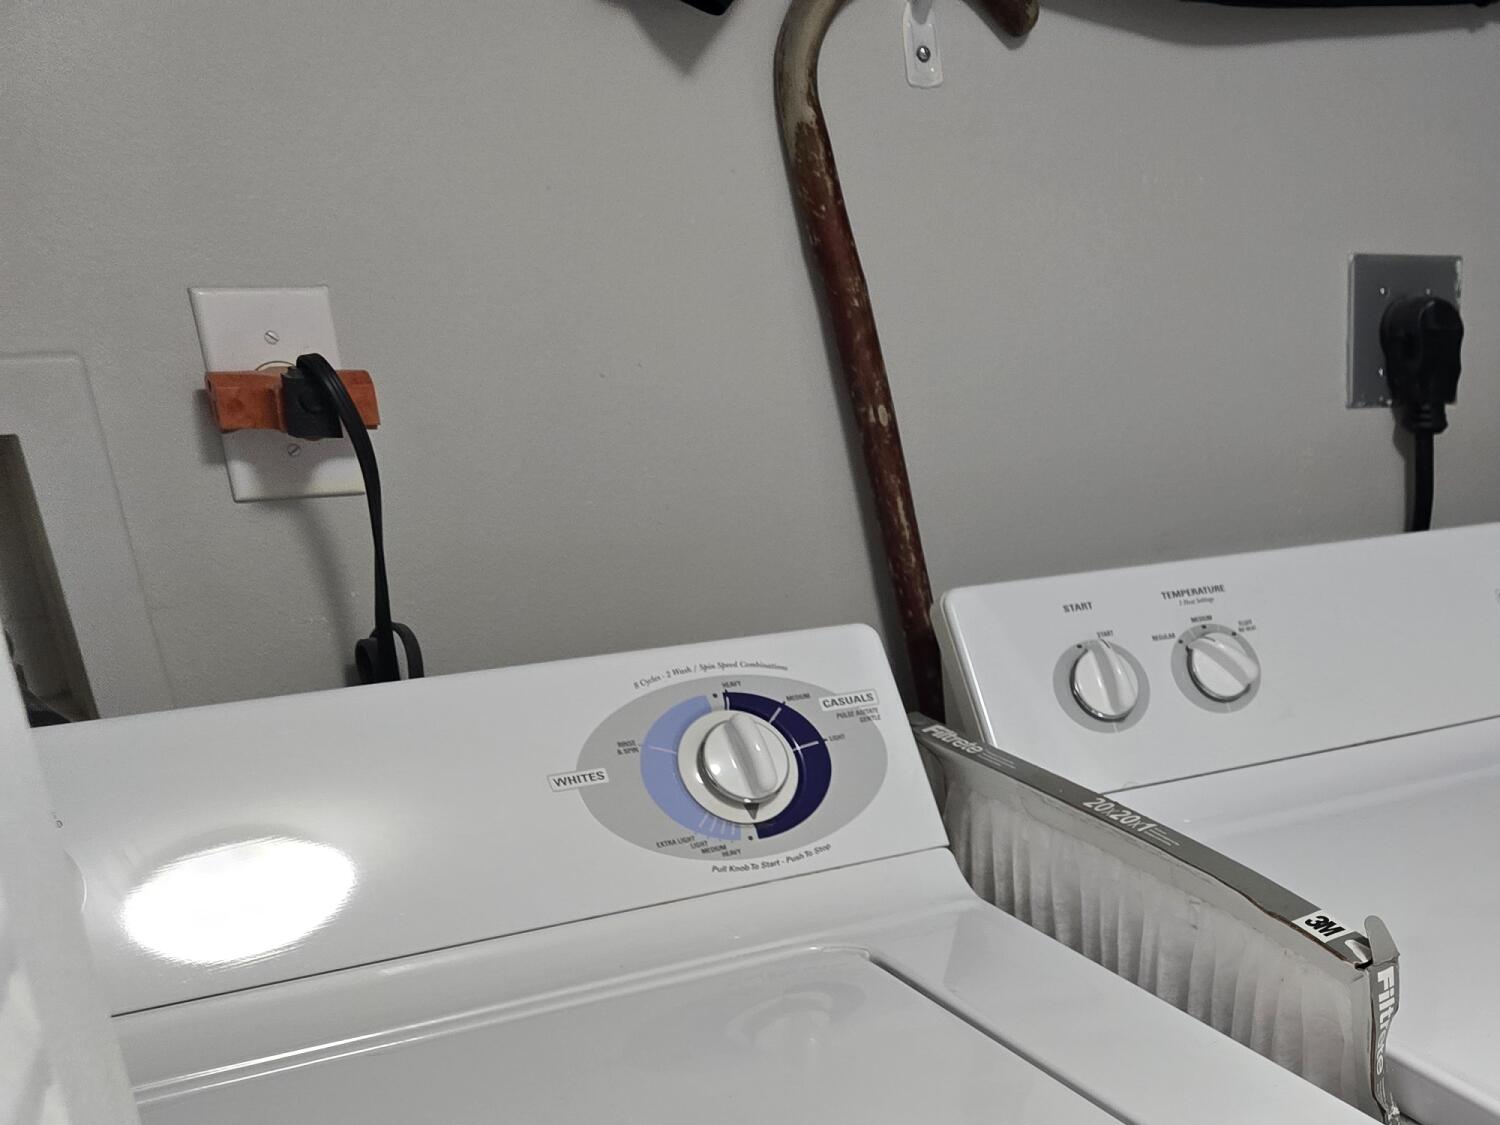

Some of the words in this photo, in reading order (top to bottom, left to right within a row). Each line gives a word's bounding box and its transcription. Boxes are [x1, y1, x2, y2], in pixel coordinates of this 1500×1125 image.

[1160, 584, 1226, 600] TEMPERATURE
[1063, 602, 1093, 613] START
[1097, 630, 1114, 638] START
[1152, 632, 1176, 642] REGULAR
[640, 675, 661, 687] Cycles
[672, 665, 693, 676] Wash
[700, 663, 716, 672] Spin
[717, 661, 738, 671] Speed
[739, 661, 788, 671] Combinations
[786, 693, 811, 702] MEDIUM
[823, 693, 874, 708] CASUALS
[829, 733, 846, 742] LIGHT
[922, 724, 984, 754] Filtrete
[553, 771, 605, 787] WHITES
[1083, 797, 1158, 832] 20x20x1
[656, 839, 677, 848] EXTRA
[677, 835, 696, 844] LIGHT
[690, 840, 708, 849] LIGHT
[701, 844, 727, 854] MEDIUM
[722, 849, 741, 857] HEAVY
[712, 865, 728, 873] Pull
[729, 864, 750, 873] Knob
[751, 862, 760, 870] To
[761, 859, 780, 869] Start
[785, 853, 804, 864] Push
[814, 844, 831, 854] Stop
[1305, 915, 1346, 937] 3M
[1376, 966, 1395, 1076] Filtrete
